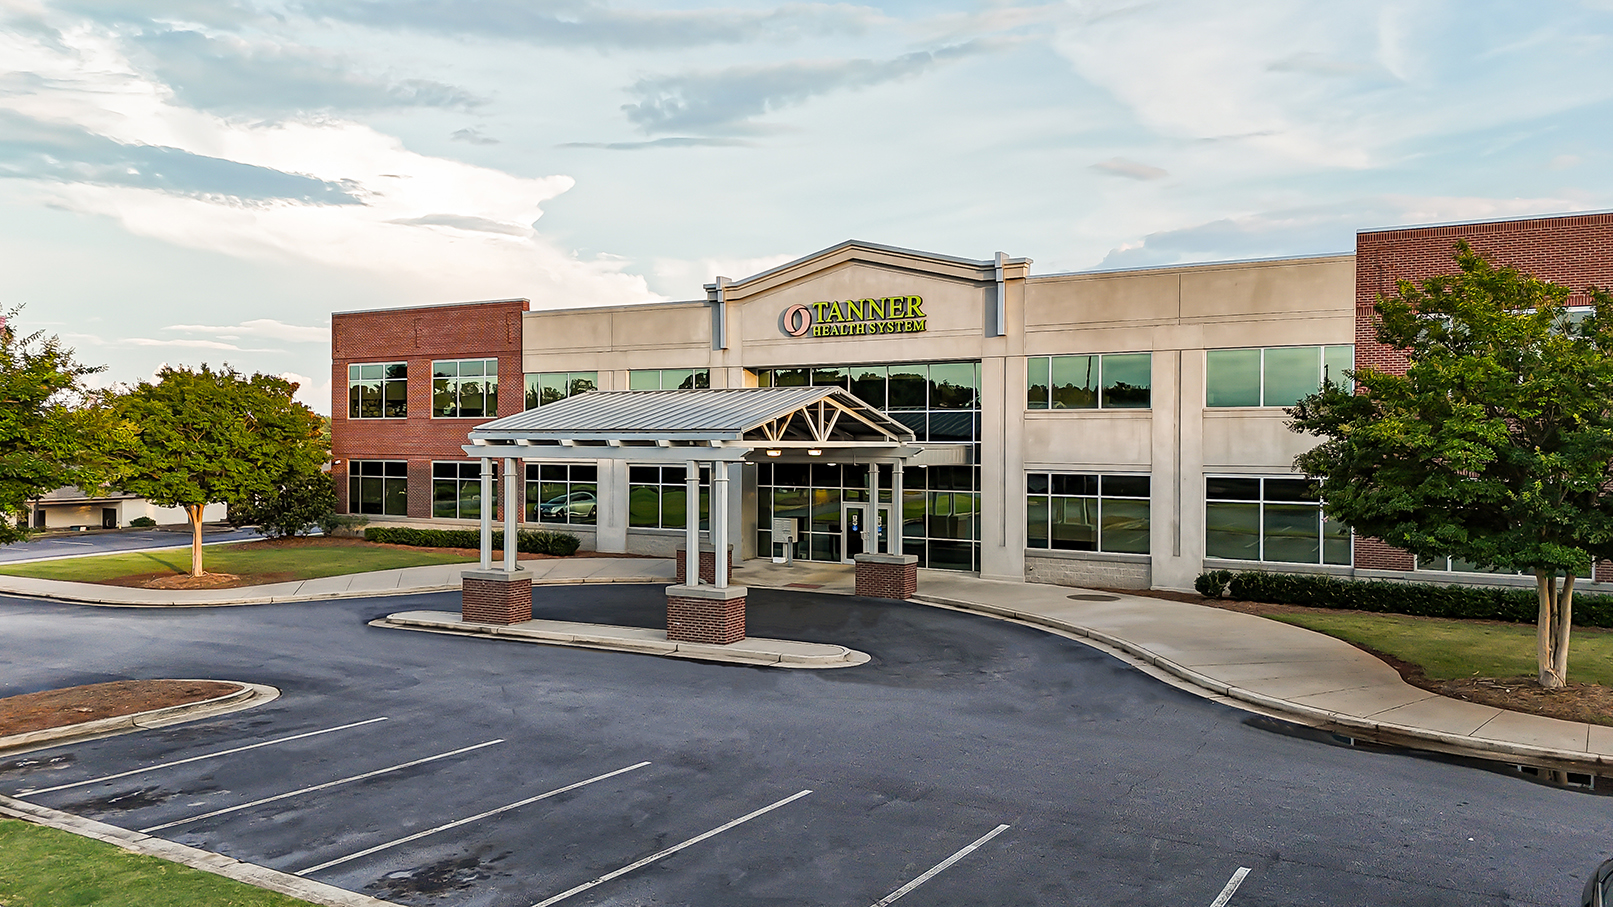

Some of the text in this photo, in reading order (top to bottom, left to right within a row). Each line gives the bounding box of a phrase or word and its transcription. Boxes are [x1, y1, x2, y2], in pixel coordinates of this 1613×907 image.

[813, 295, 926, 323] TANNER
[813, 320, 926, 337] HEALTH SYSTEM
